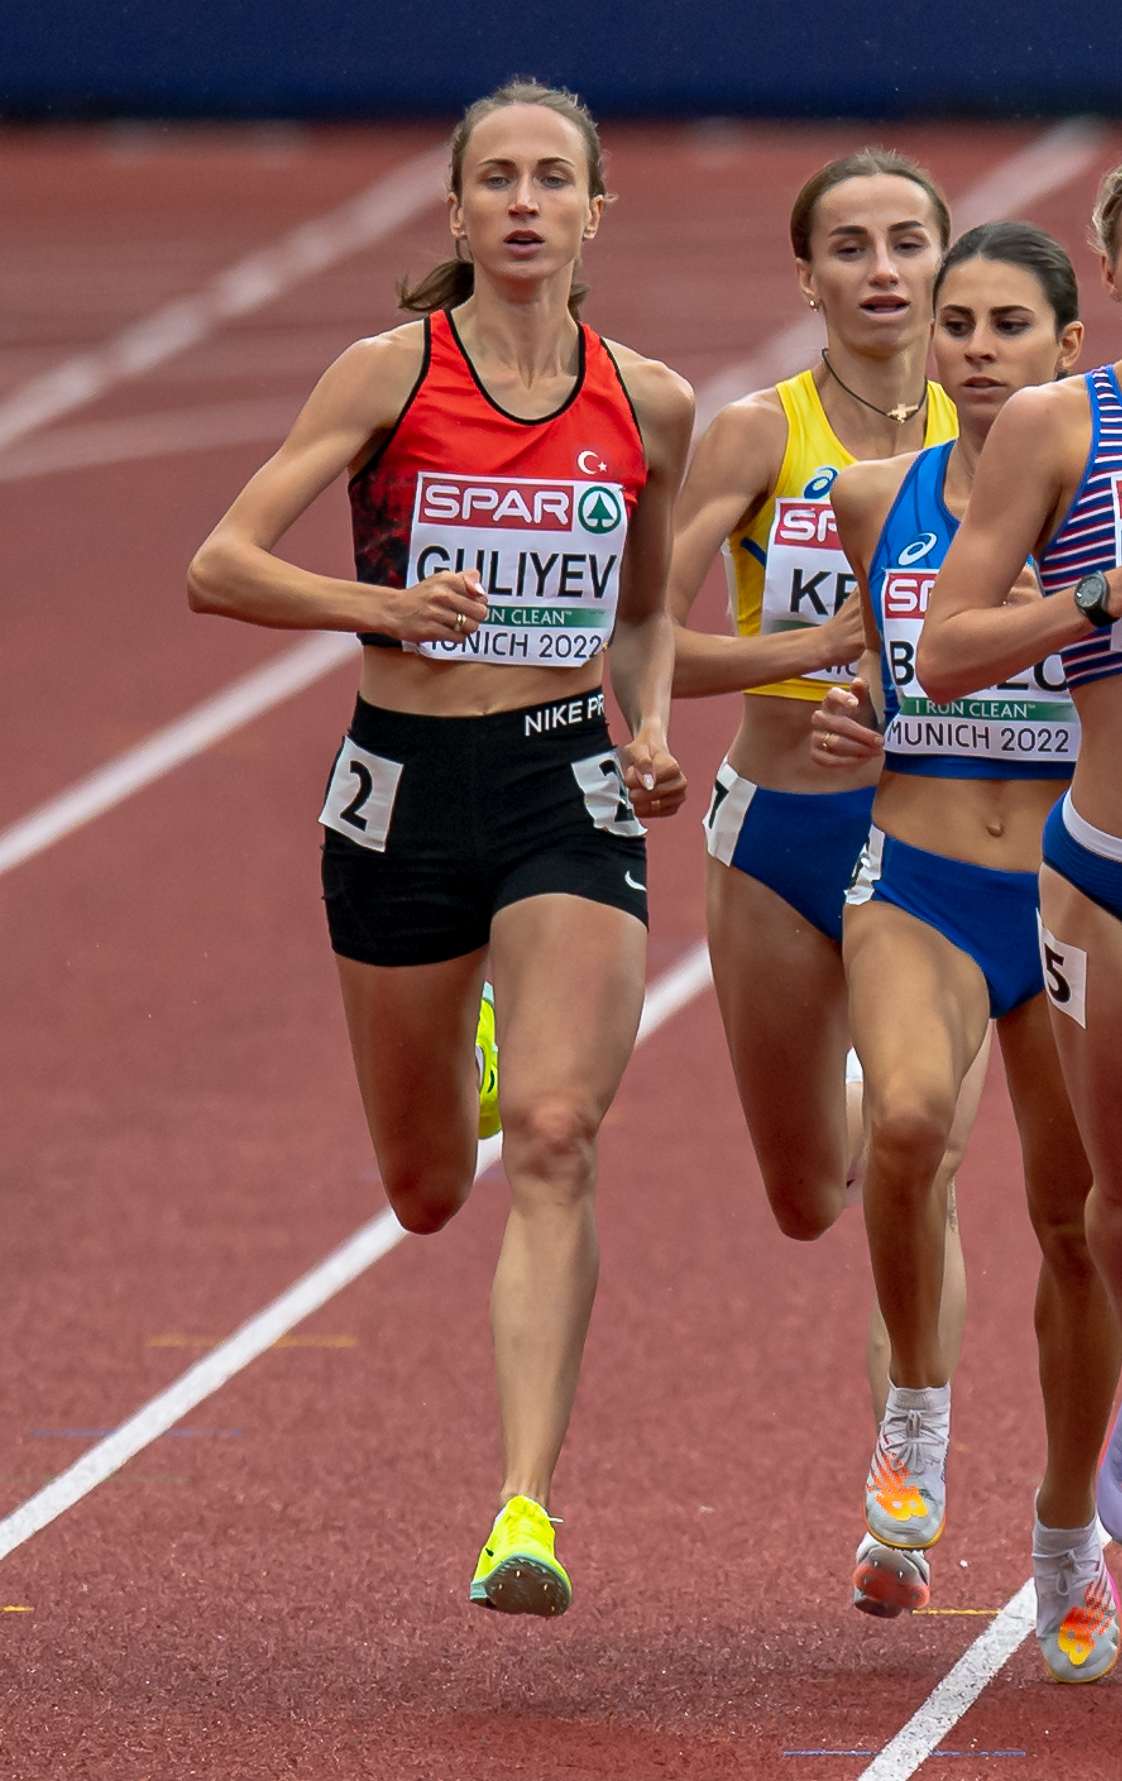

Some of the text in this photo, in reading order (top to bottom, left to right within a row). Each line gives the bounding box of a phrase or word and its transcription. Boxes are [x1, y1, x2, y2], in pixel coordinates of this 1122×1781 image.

[424, 485, 570, 525] SPAR
[538, 633, 603, 659] 2022
[524, 700, 584, 737] NIKE
[926, 701, 964, 717] RUN
[887, 721, 1070, 753] MUNICH 2022
[339, 759, 373, 833] 2
[1043, 942, 1071, 1004] 5
